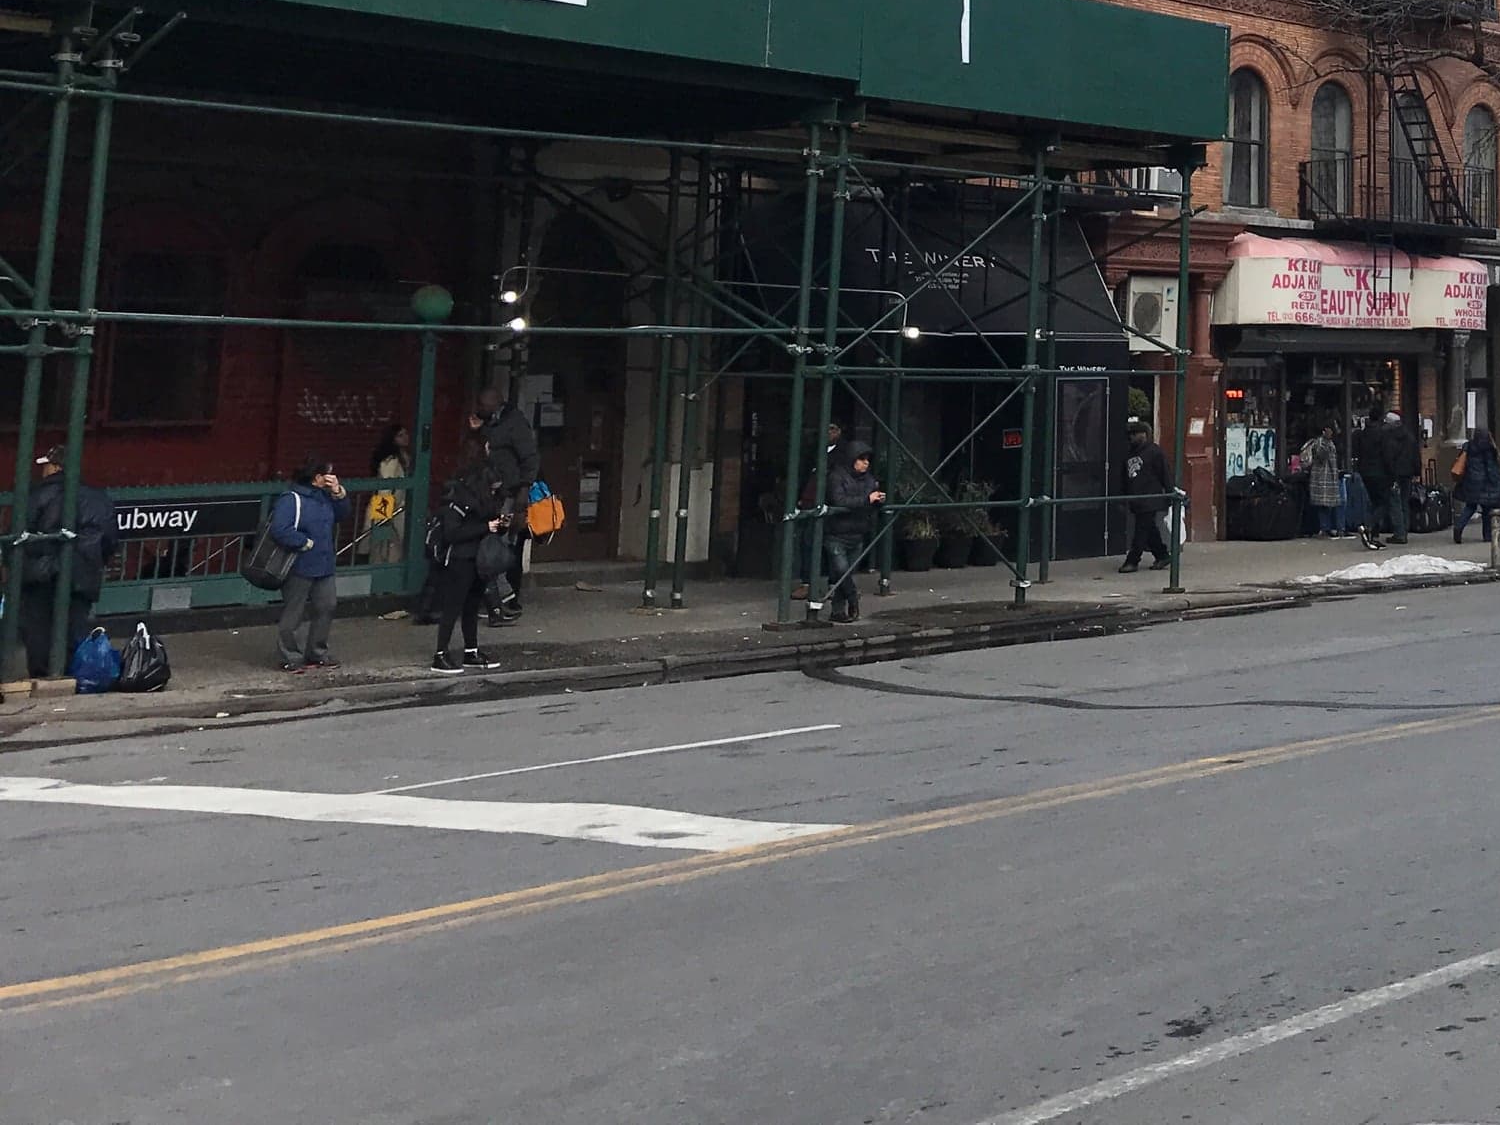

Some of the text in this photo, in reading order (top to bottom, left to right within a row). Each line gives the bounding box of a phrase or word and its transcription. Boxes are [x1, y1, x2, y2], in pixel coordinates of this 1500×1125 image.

[1271, 274, 1305, 290] ADJA
[1444, 284, 1473, 299] ADJA
[1320, 289, 1411, 317] EAUTY SUPPLY
[117, 507, 198, 532] ubway
